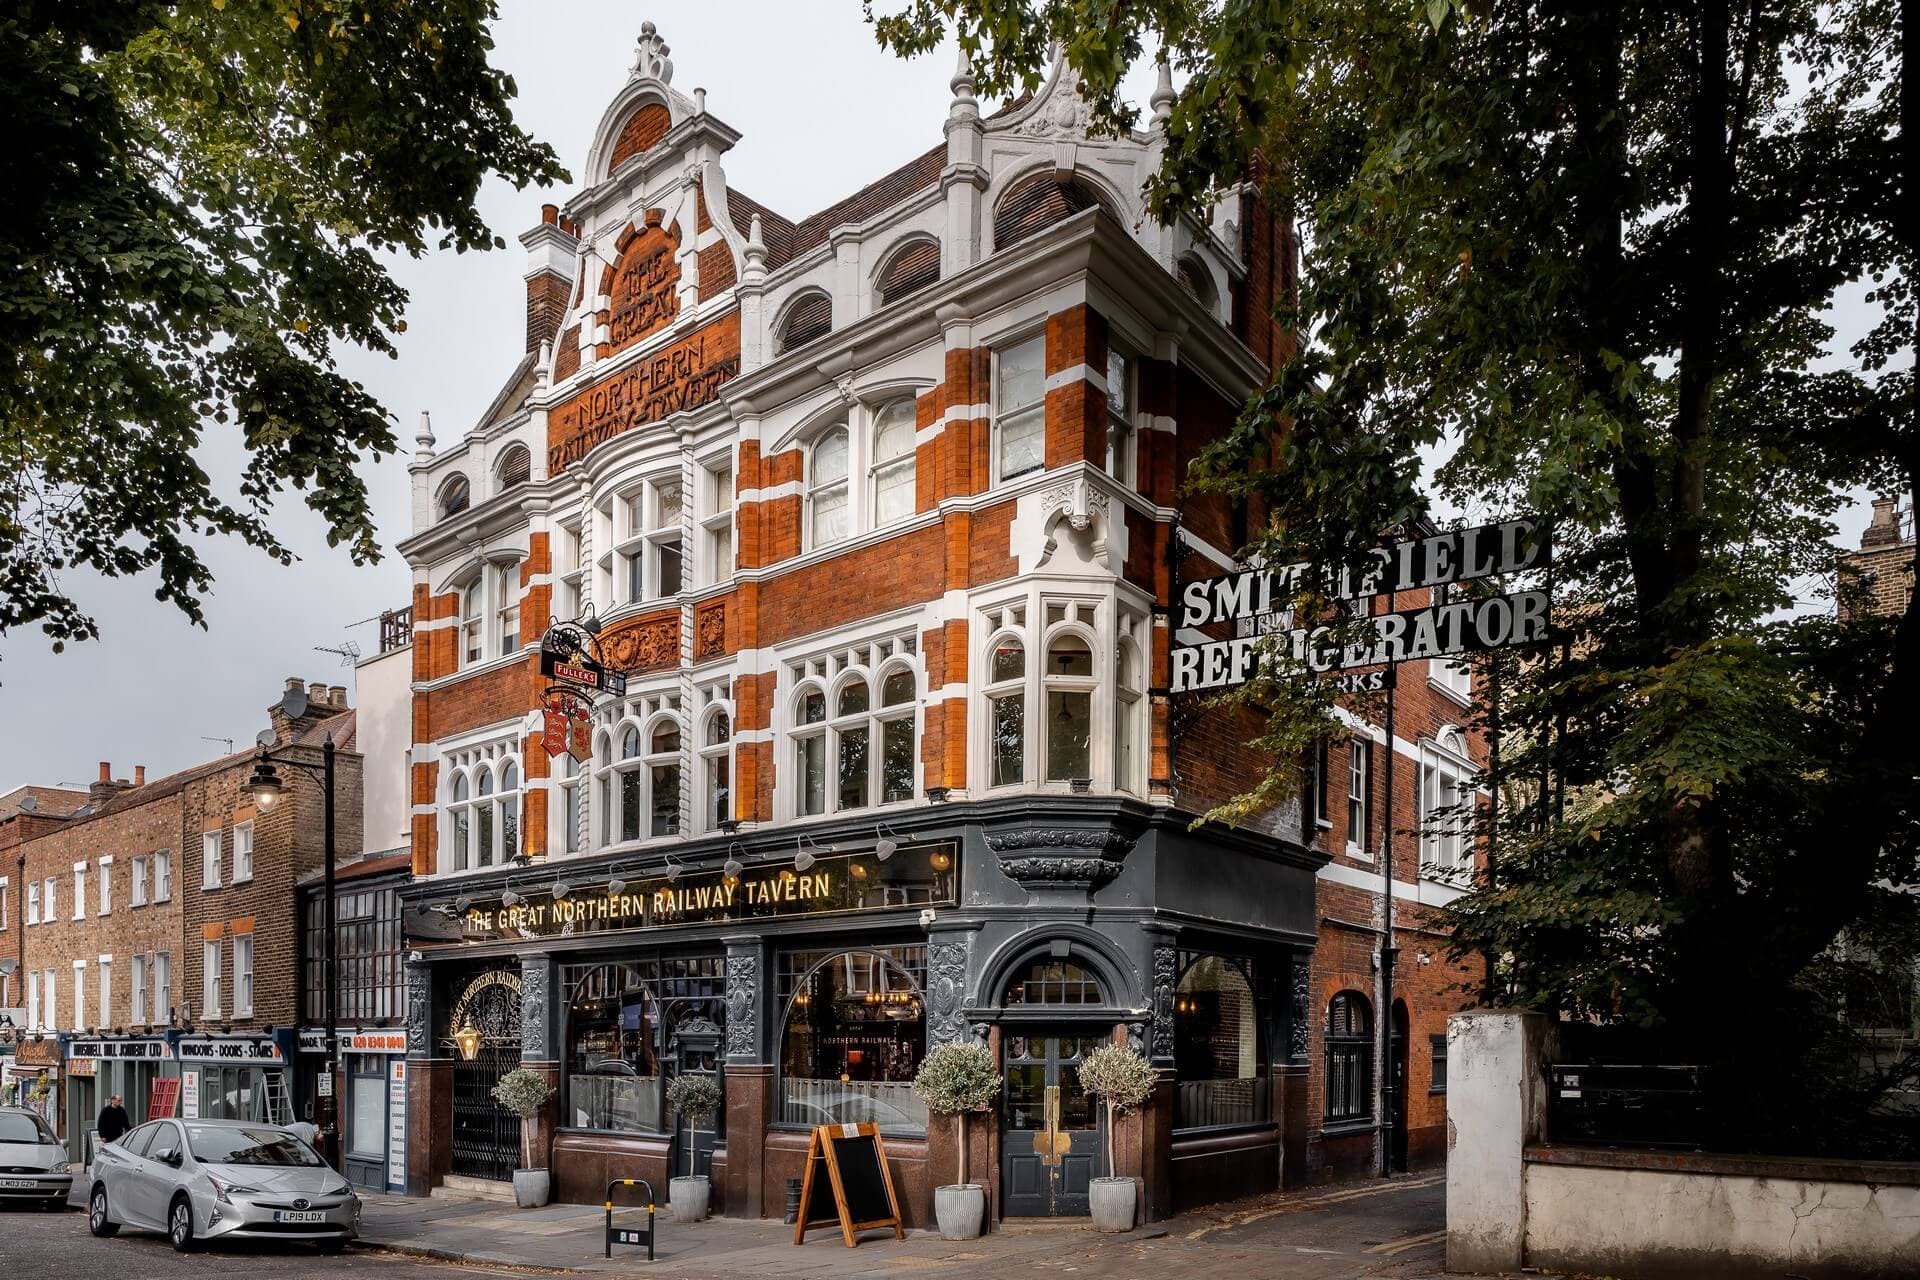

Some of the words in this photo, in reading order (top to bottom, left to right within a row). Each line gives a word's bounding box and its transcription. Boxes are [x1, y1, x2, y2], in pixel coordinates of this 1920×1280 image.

[622, 252, 669, 301] THE
[610, 282, 677, 347] GREAT
[577, 335, 706, 430] NORTHERN
[645, 357, 741, 424] TAVERN
[557, 664, 595, 682] FULLER'S
[1303, 670, 1385, 698] WRKS
[466, 911, 492, 932] THE
[498, 905, 546, 929] GREAT
[552, 894, 644, 923] NORTHERN
[653, 883, 736, 914] RAILWAY
[745, 872, 830, 904] TAVERN
[462, 971, 495, 1005] NORTHERN
[496, 971, 522, 996] RAILWA
[149, 1043, 162, 1056] LTD
[181, 1044, 214, 1057] WINDOWS
[219, 1045, 243, 1057] DOORS
[248, 1045, 273, 1058] STAIRS
[353, 1036, 367, 1048] 020
[283, 1212, 304, 1221] LP19
[305, 1212, 322, 1221] LDX
